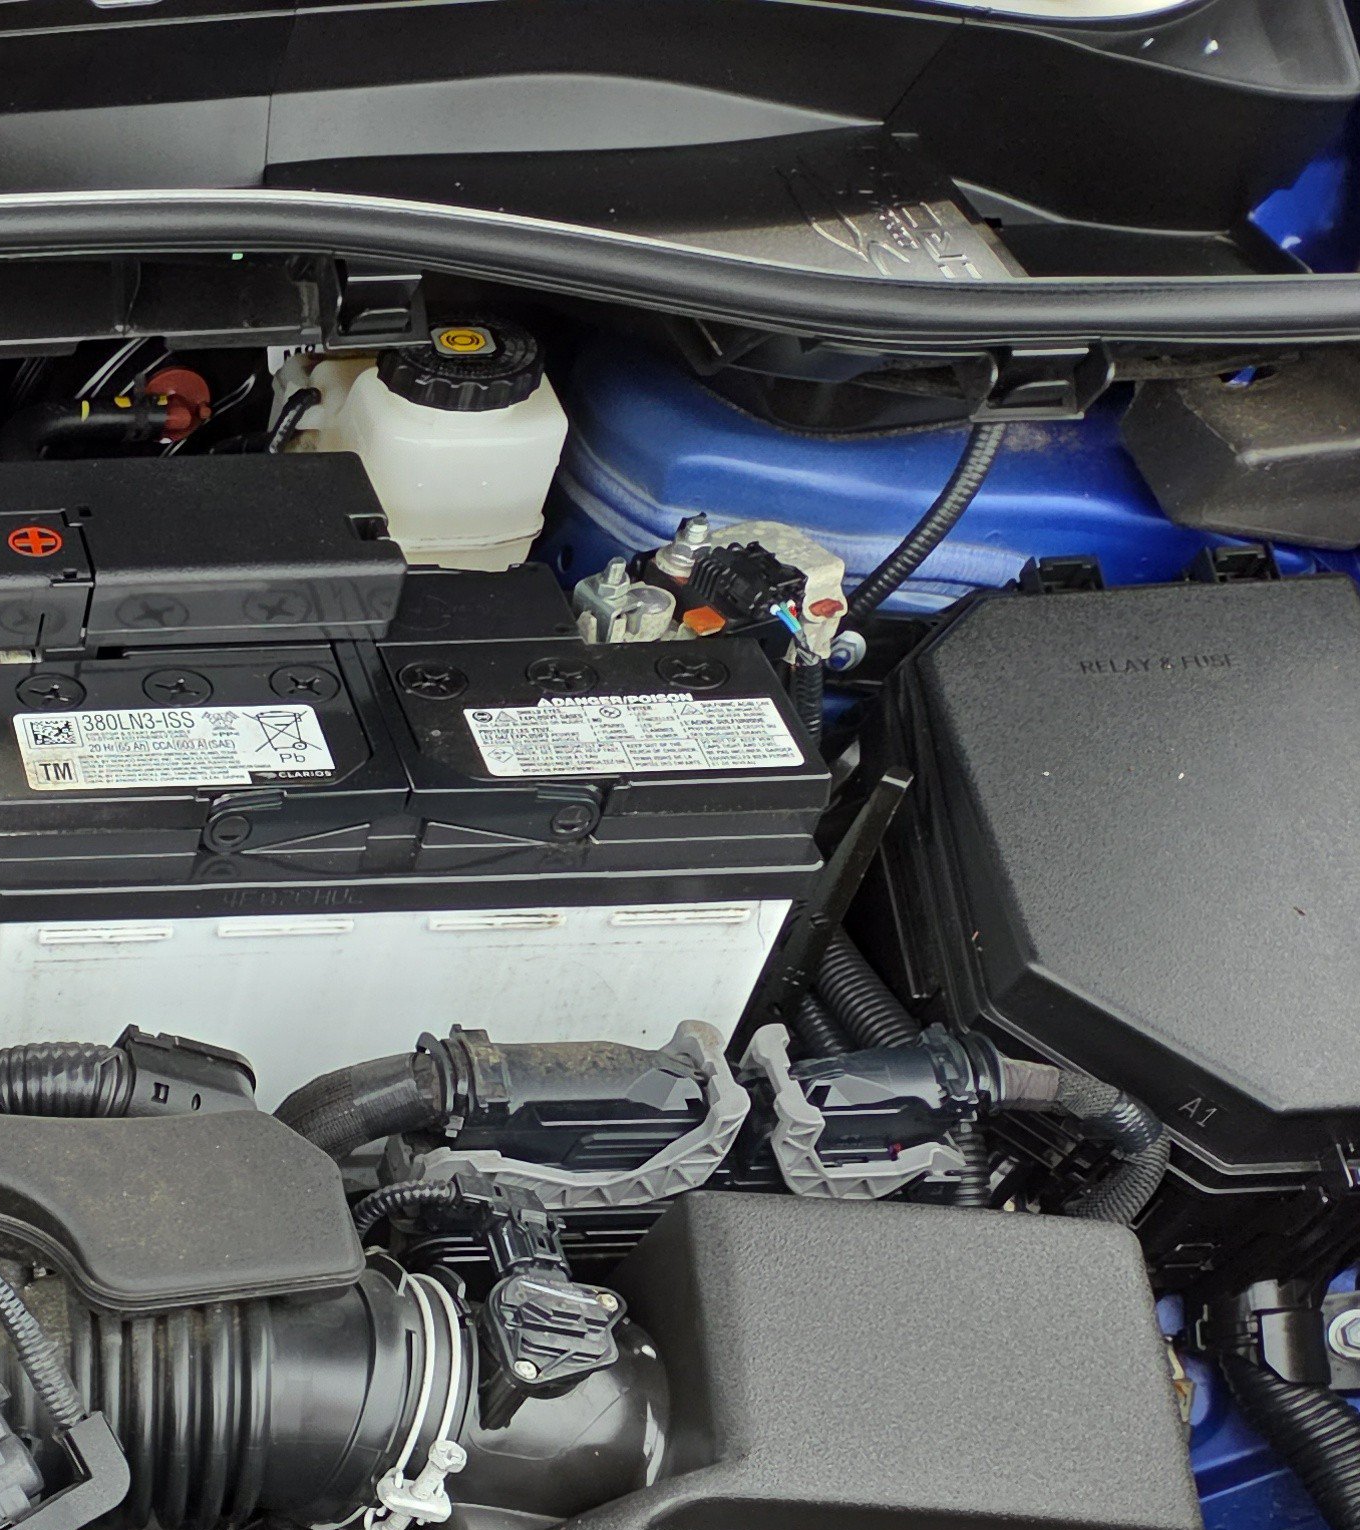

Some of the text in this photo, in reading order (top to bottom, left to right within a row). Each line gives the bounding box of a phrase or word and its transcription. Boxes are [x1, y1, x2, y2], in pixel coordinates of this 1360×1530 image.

[82, 710, 196, 732] 380LN3-ISS
[280, 752, 306, 764] Pb
[39, 761, 74, 782] TM
[278, 768, 333, 780] CLARIOS
[1178, 1097, 1218, 1128] A1
